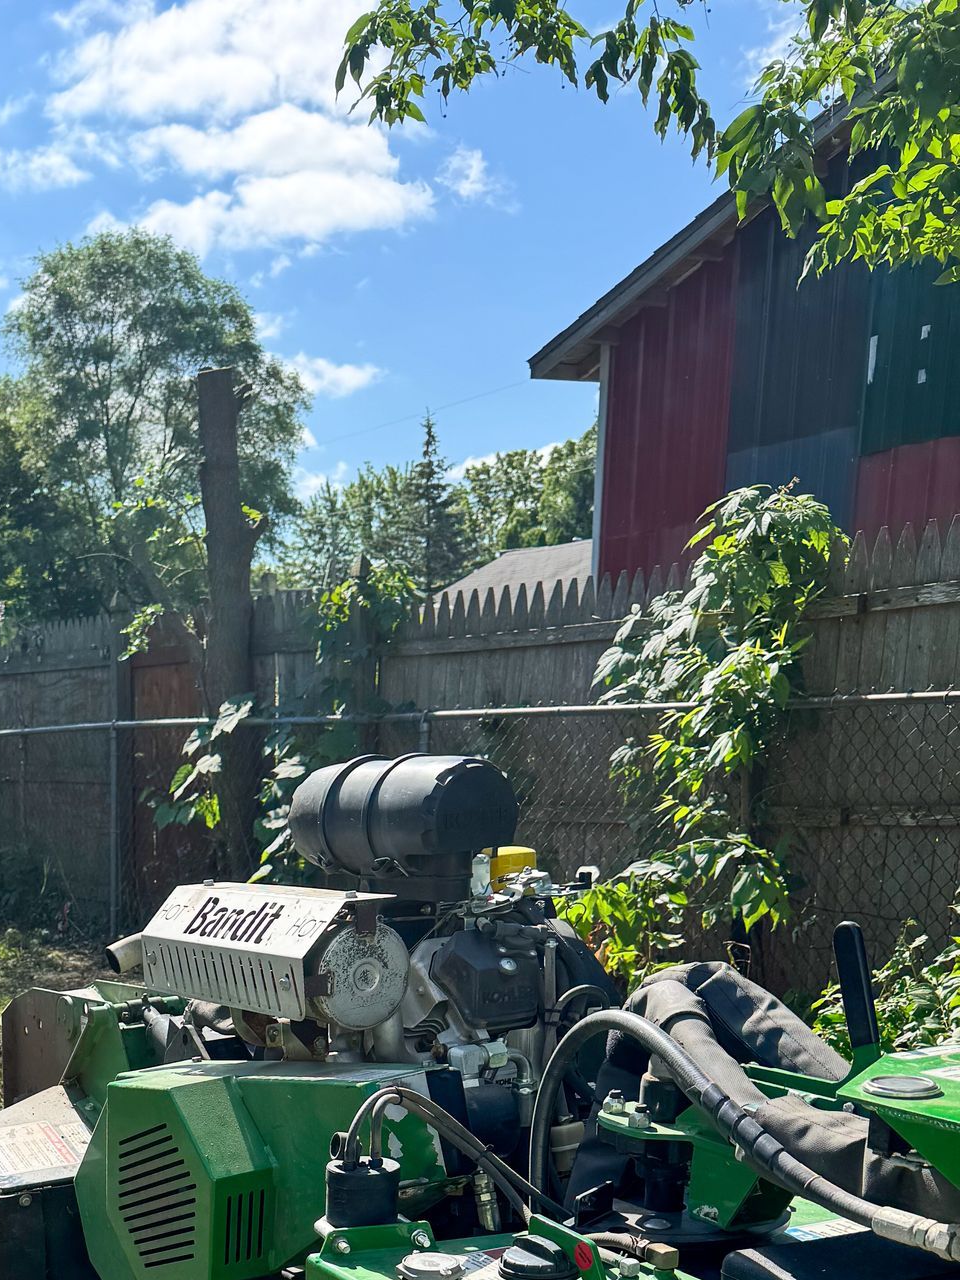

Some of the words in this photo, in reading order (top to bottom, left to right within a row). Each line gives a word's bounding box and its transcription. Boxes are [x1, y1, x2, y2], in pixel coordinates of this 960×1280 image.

[157, 902, 188, 922] HOT
[182, 896, 285, 945] Bandit
[285, 917, 328, 938] HOT
